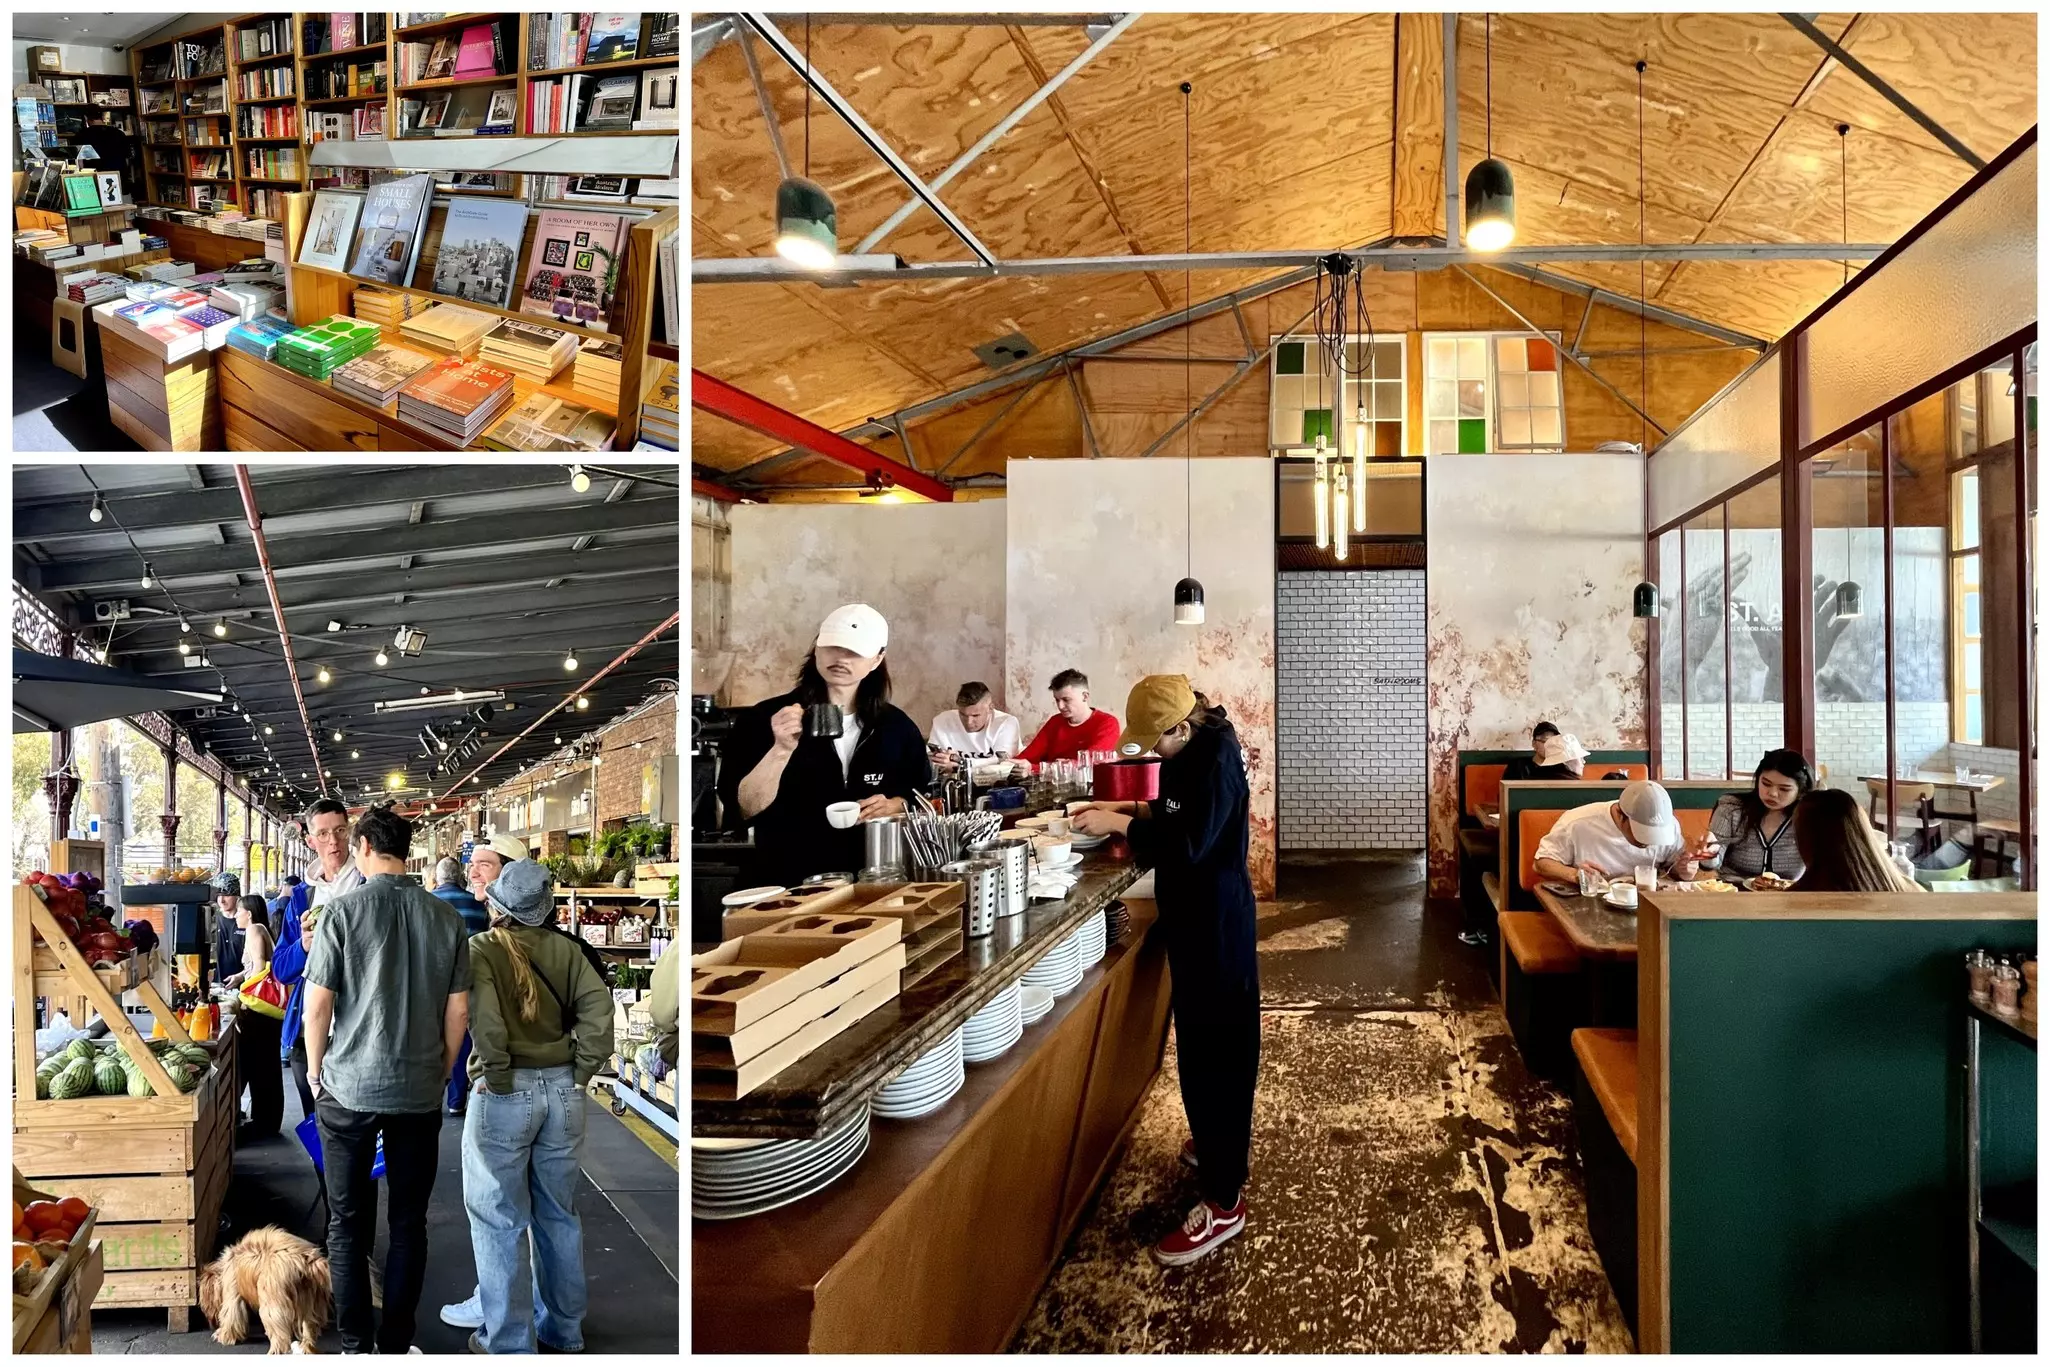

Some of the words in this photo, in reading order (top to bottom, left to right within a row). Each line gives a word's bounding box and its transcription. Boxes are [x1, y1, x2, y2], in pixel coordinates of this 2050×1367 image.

[380, 187, 411, 198] SMALL
[373, 197, 412, 209] HOUSES
[551, 217, 572, 225] ROOM
[583, 219, 598, 227] HER
[451, 355, 506, 378] Artists
[441, 368, 489, 388] Home
[463, 369, 482, 378] at
[1730, 601, 1759, 622] ST.
